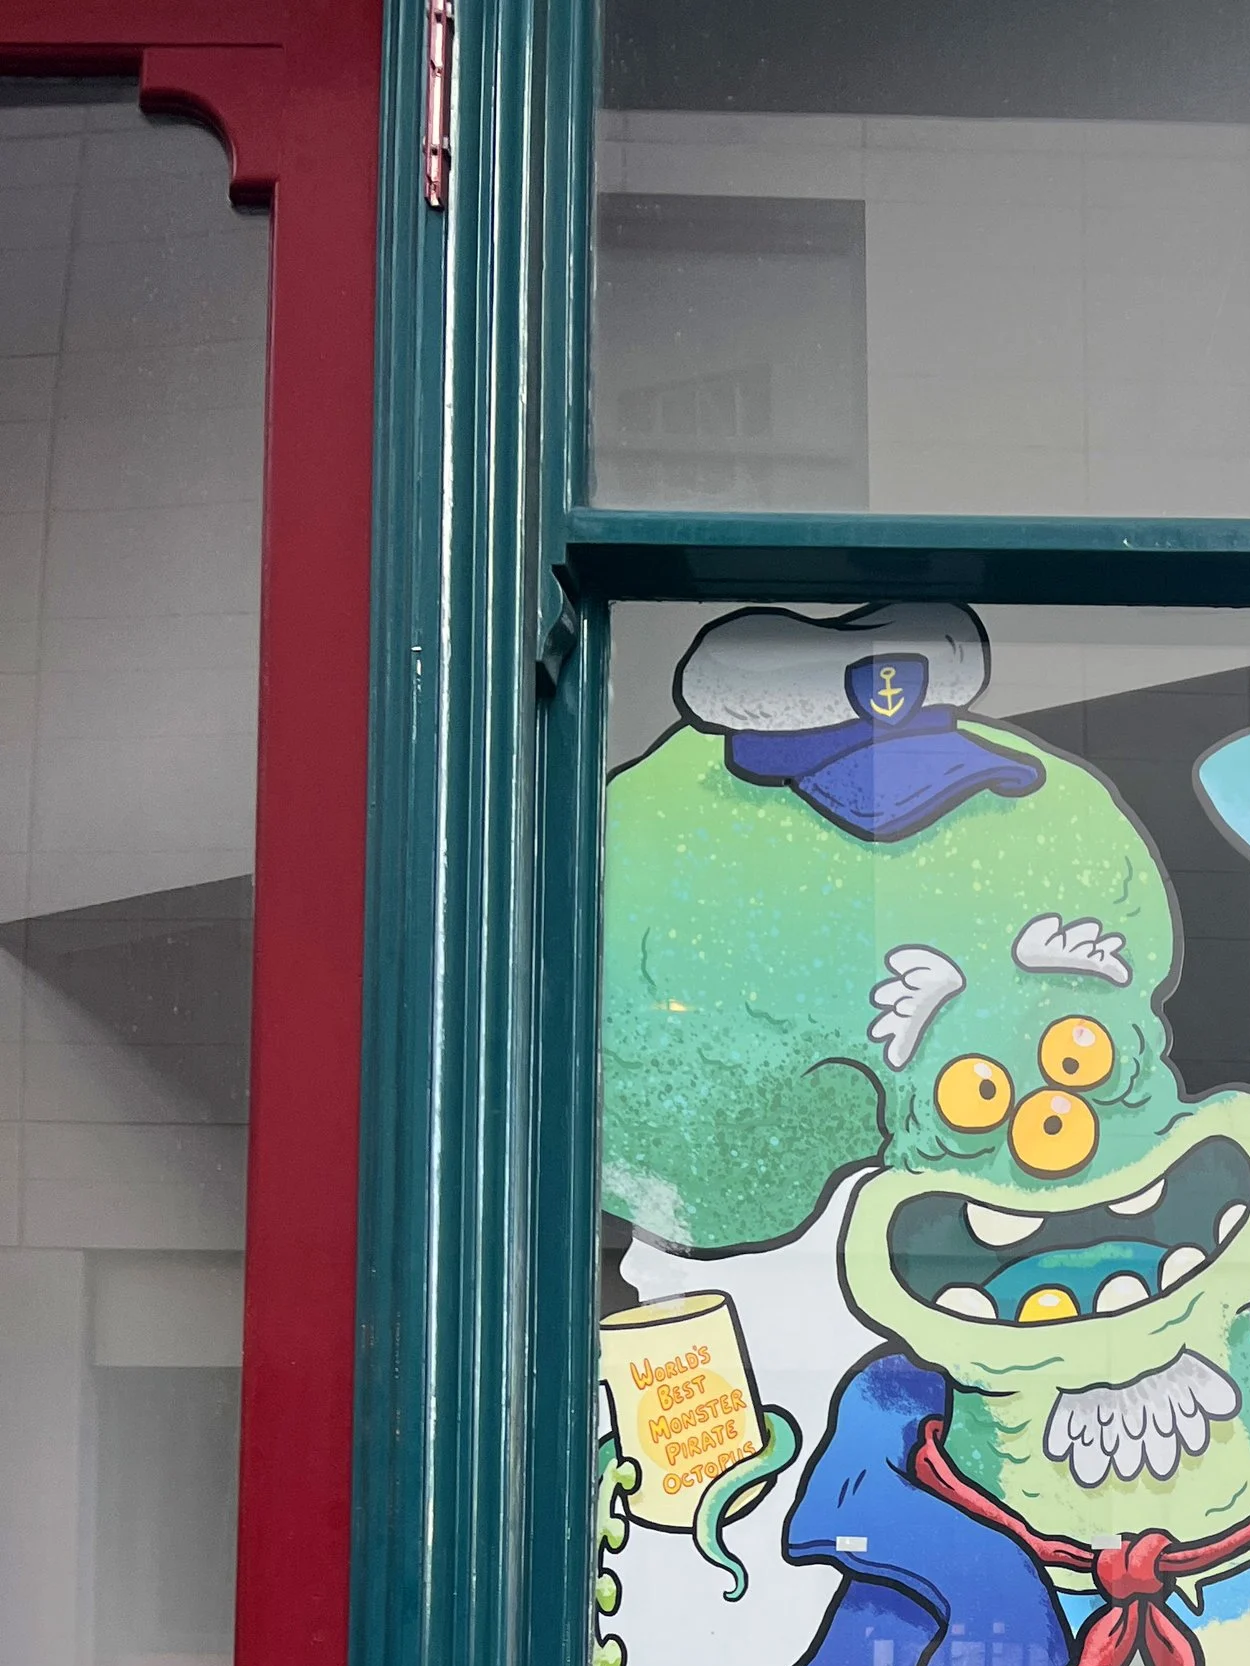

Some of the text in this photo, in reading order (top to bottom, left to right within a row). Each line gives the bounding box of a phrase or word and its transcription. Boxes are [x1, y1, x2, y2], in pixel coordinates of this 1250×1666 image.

[648, 1388, 747, 1444] MONSTER
[656, 1375, 706, 1411] BEST
[665, 1419, 739, 1466] PIRATE
